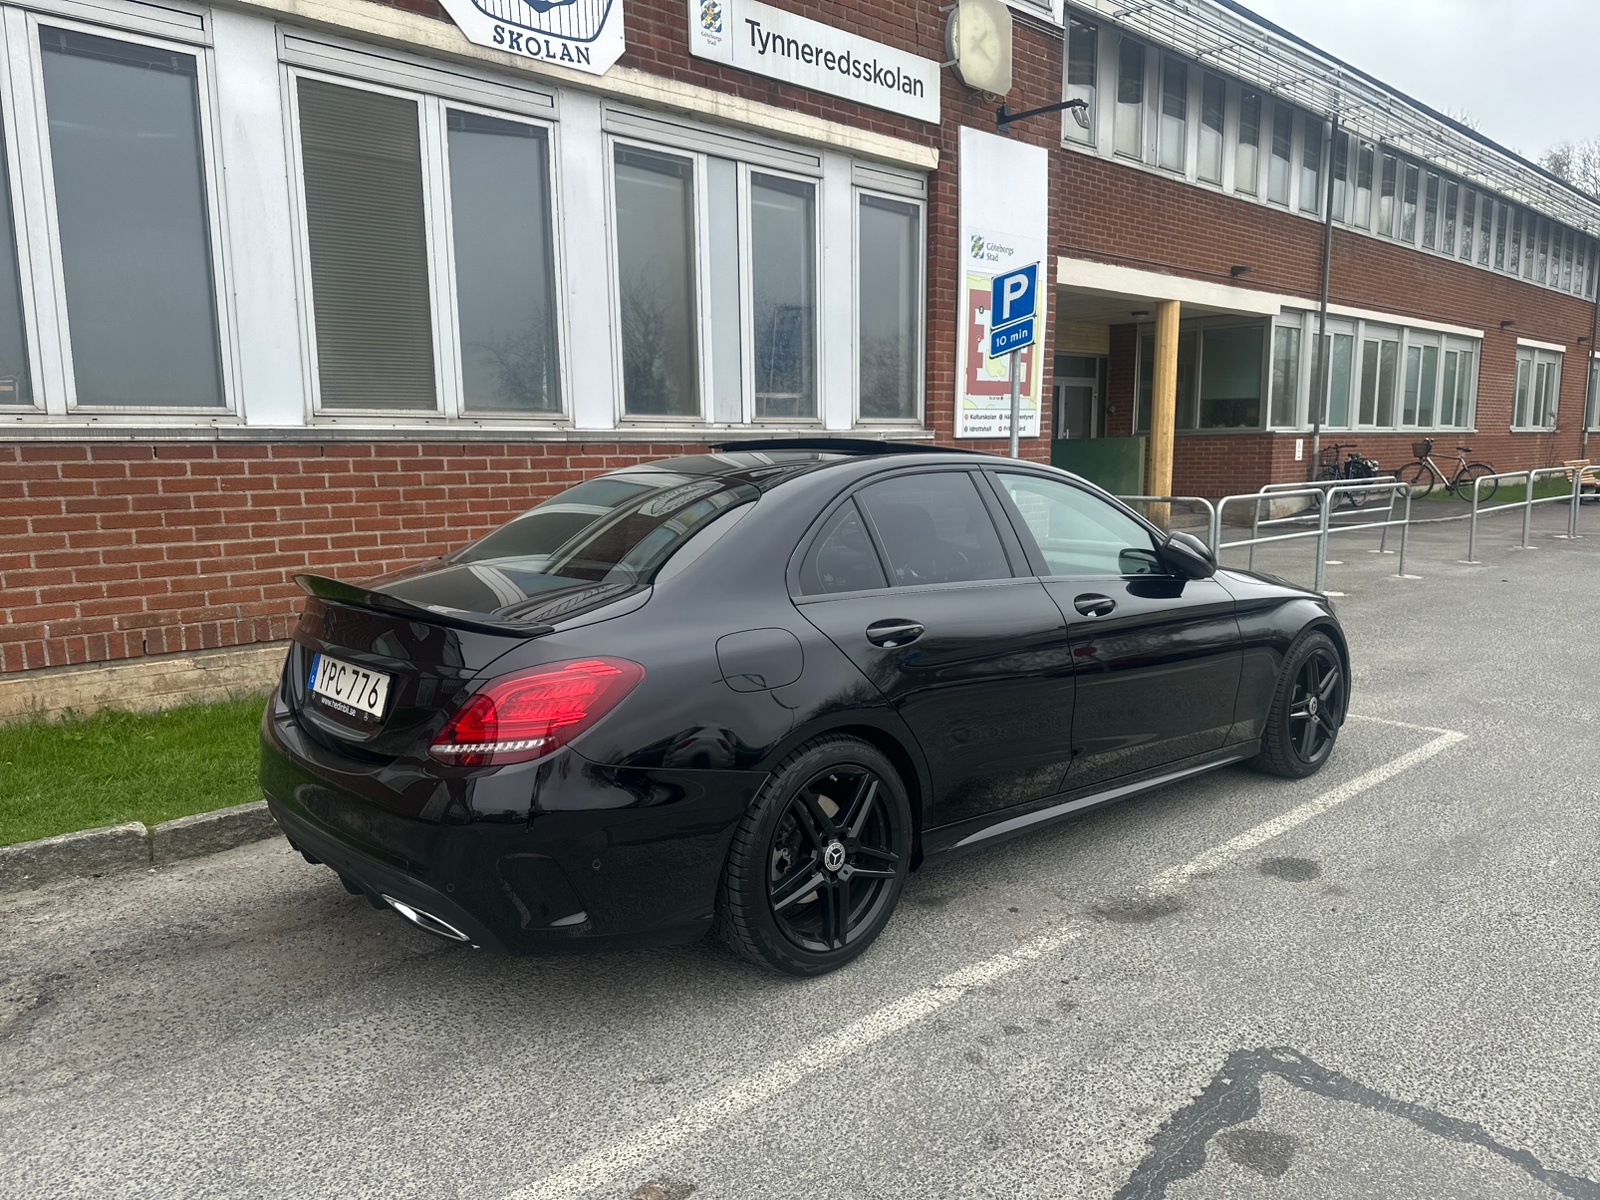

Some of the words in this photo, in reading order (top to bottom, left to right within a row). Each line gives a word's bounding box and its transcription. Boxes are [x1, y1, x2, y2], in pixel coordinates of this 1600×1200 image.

[493, 25, 590, 65] SKOLAN
[745, 18, 924, 98] Tynneredsskolan
[986, 242, 1014, 256] Göteborgs
[986, 253, 998, 262] Stad
[1002, 273, 1029, 320] P
[996, 335, 1007, 347] 10
[1010, 329, 1028, 342] min
[320, 659, 346, 696] YPC
[347, 669, 380, 709] 776
[321, 696, 357, 717] www.hedinbil.se
